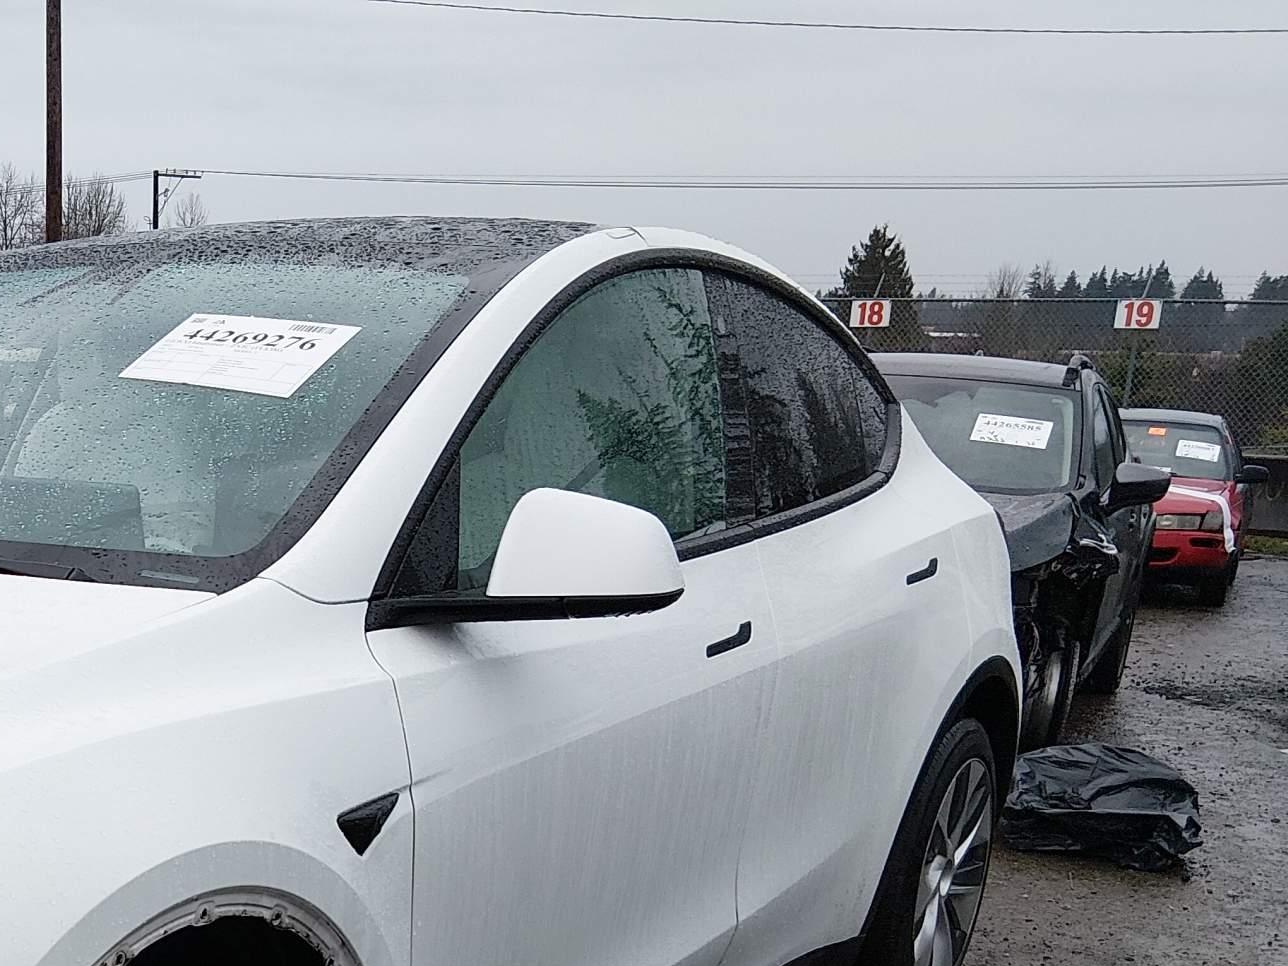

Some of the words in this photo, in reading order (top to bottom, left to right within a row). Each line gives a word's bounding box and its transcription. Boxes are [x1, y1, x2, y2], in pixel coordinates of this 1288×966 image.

[857, 301, 884, 326] 18
[1124, 301, 1154, 327] 19
[184, 329, 320, 350] 44269276
